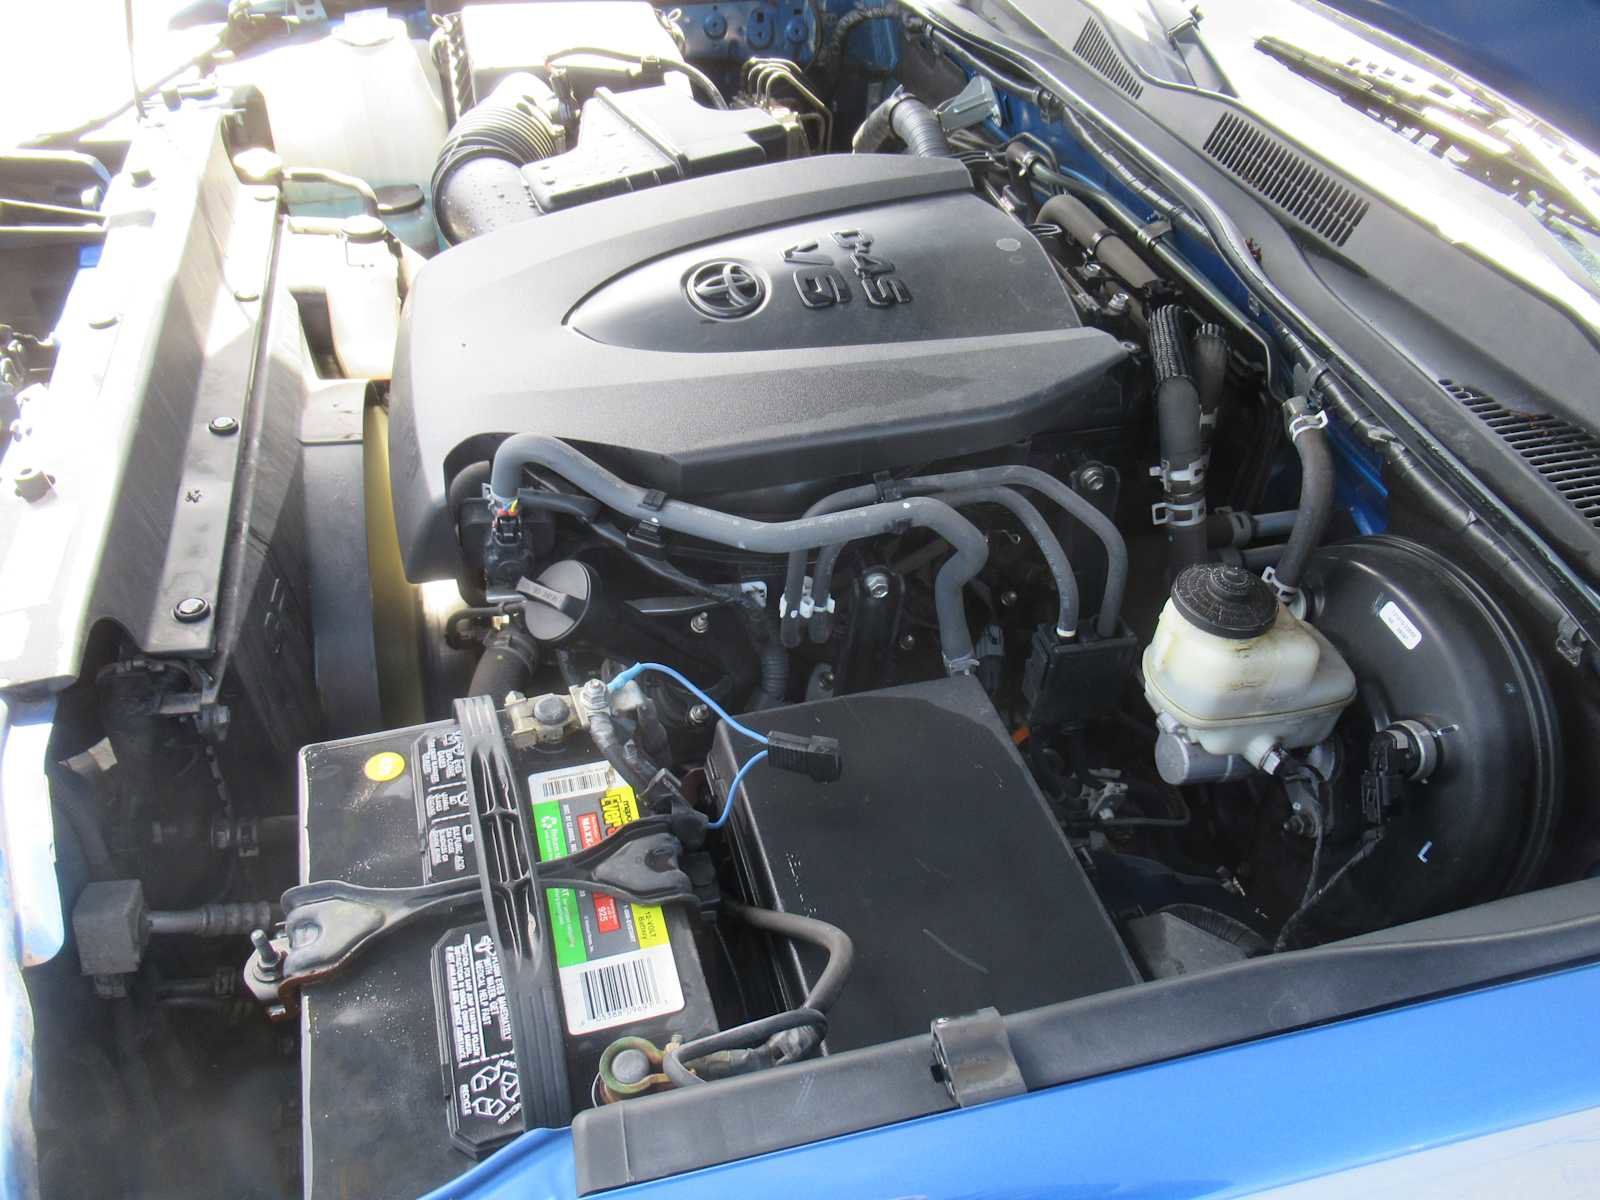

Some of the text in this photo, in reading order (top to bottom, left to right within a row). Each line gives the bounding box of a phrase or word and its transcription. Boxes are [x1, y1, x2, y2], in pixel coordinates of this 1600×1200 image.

[780, 240, 853, 308] V6
[454, 855, 465, 871] ACID
[597, 905, 608, 922] 925
[478, 989, 489, 1007] HELP
[481, 1008, 491, 1026] FAST
[489, 1001, 499, 1015] GET
[460, 1084, 473, 1116] RECYCLE
